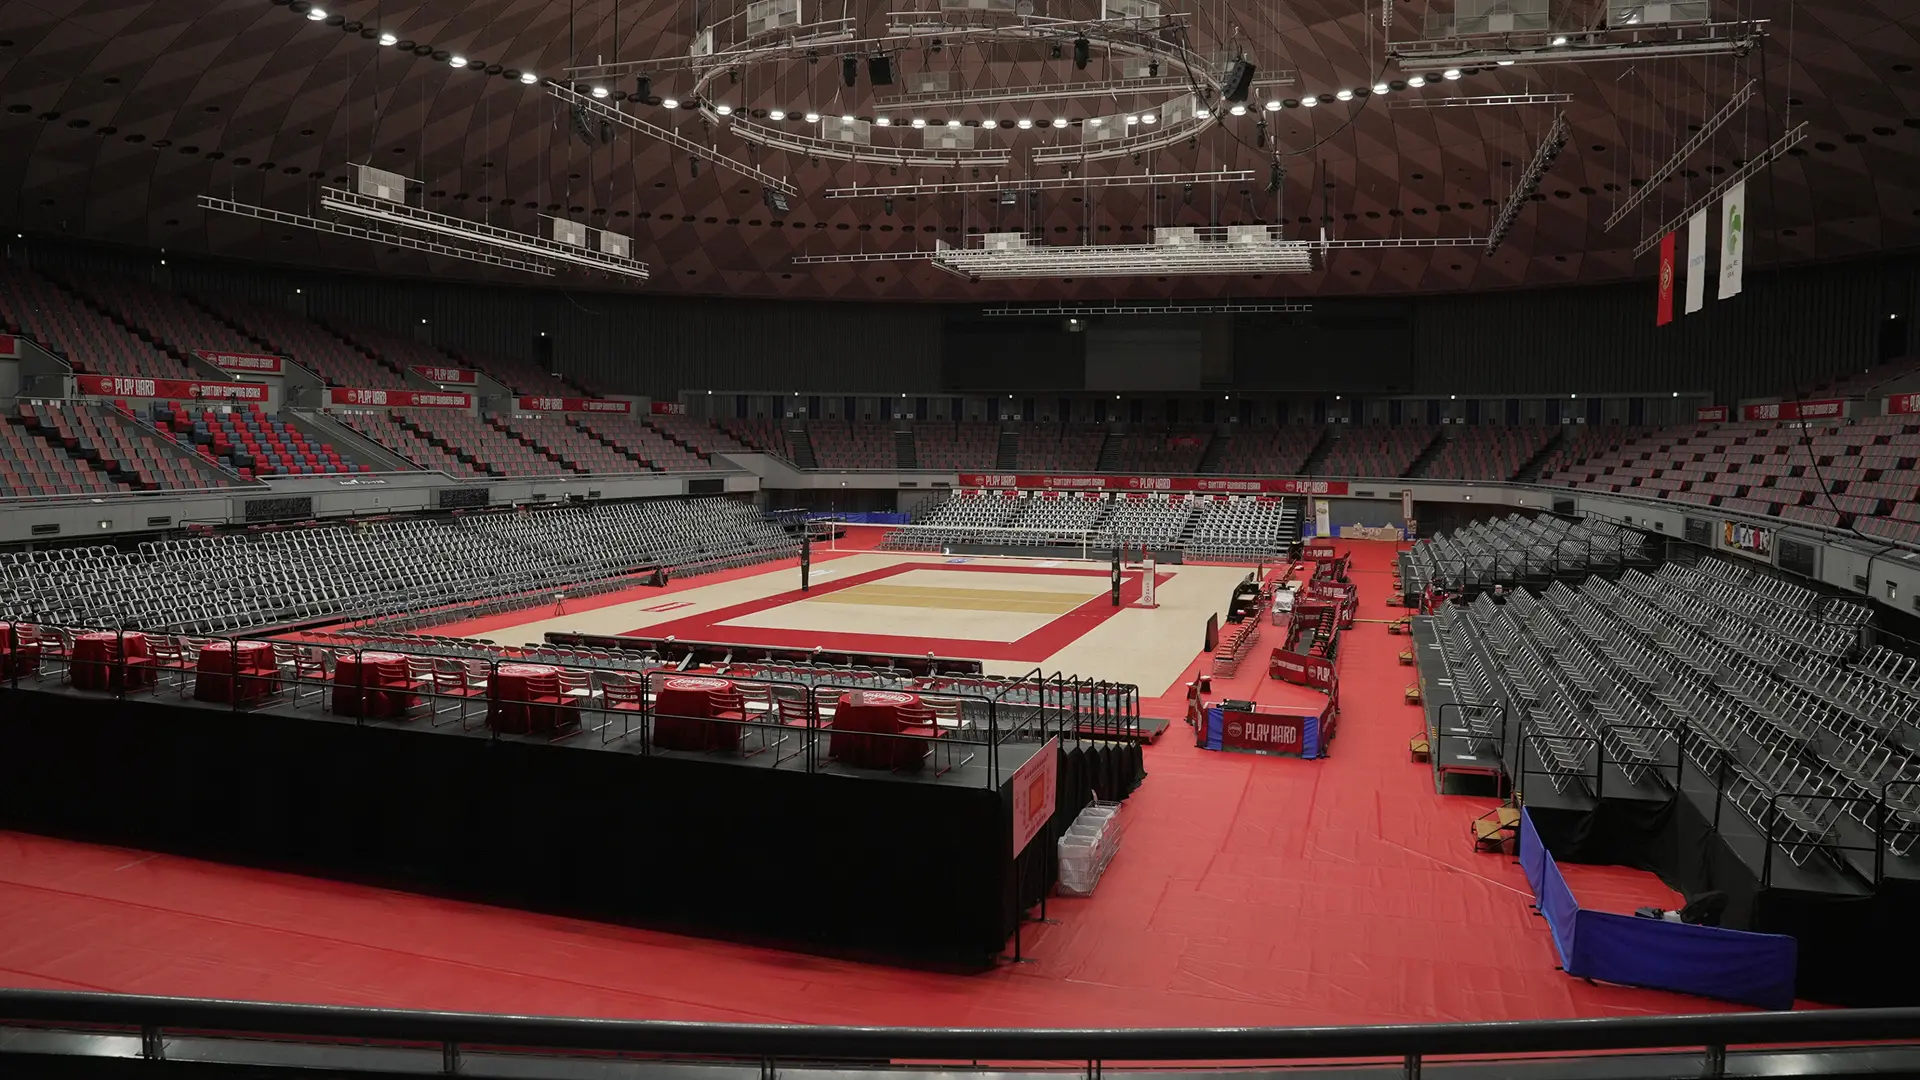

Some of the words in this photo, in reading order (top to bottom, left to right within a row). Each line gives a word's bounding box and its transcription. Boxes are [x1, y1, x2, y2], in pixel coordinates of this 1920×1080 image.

[115, 378, 134, 395] PLAY
[135, 379, 155, 396] HARD
[358, 390, 372, 404] PLAY
[985, 475, 1000, 486] PLAY
[1001, 475, 1016, 486] HARD
[1140, 478, 1155, 488] PLAY
[1155, 478, 1171, 489] HARD
[1312, 482, 1328, 493] HARD
[1316, 666, 1330, 682] PLAY
[1245, 722, 1269, 742] PLAY
[1271, 725, 1296, 744] HARD
